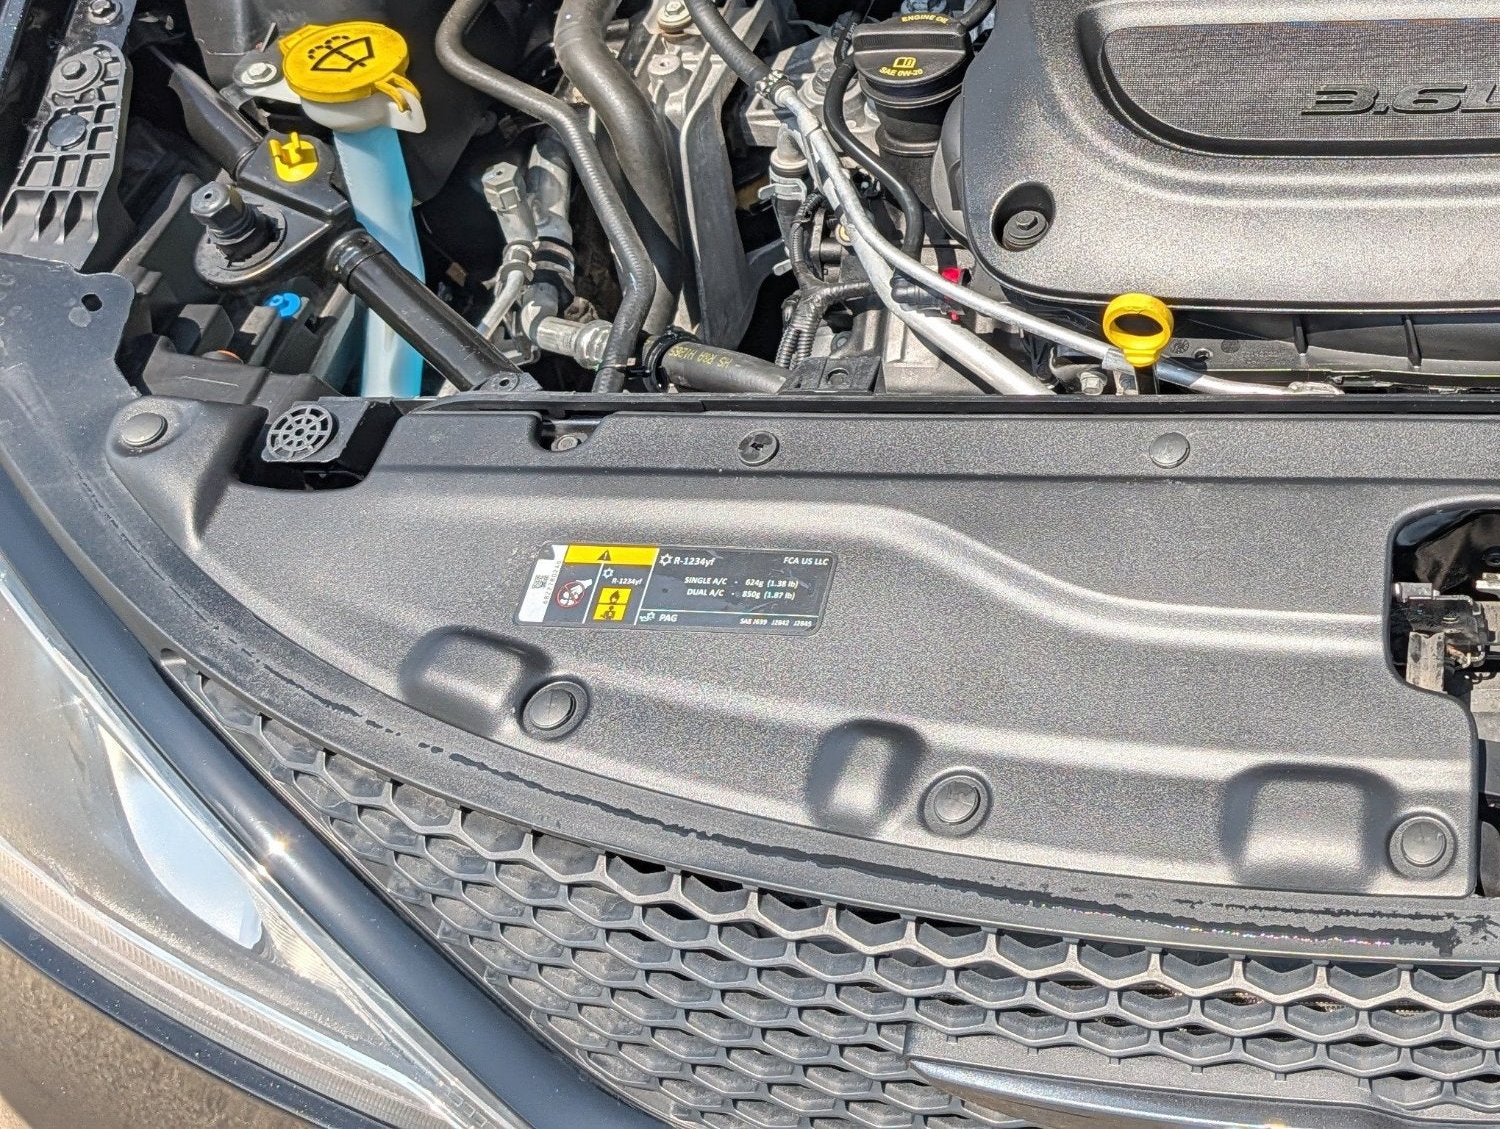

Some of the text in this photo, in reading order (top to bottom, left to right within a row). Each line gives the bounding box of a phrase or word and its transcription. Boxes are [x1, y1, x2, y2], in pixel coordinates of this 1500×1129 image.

[901, 14, 950, 24] ENGINE OIL
[879, 66, 924, 77] SAE 0W-20
[673, 554, 830, 568] R-1234yf FCA US LLC
[611, 576, 643, 586] R-1234yf
[684, 576, 799, 589] SINGLE A/C 624g (1.38 lb)
[686, 588, 796, 601] DUAL A/C 850g (1.87 lb)
[658, 613, 678, 623] PAG
[739, 617, 752, 625] SAE
